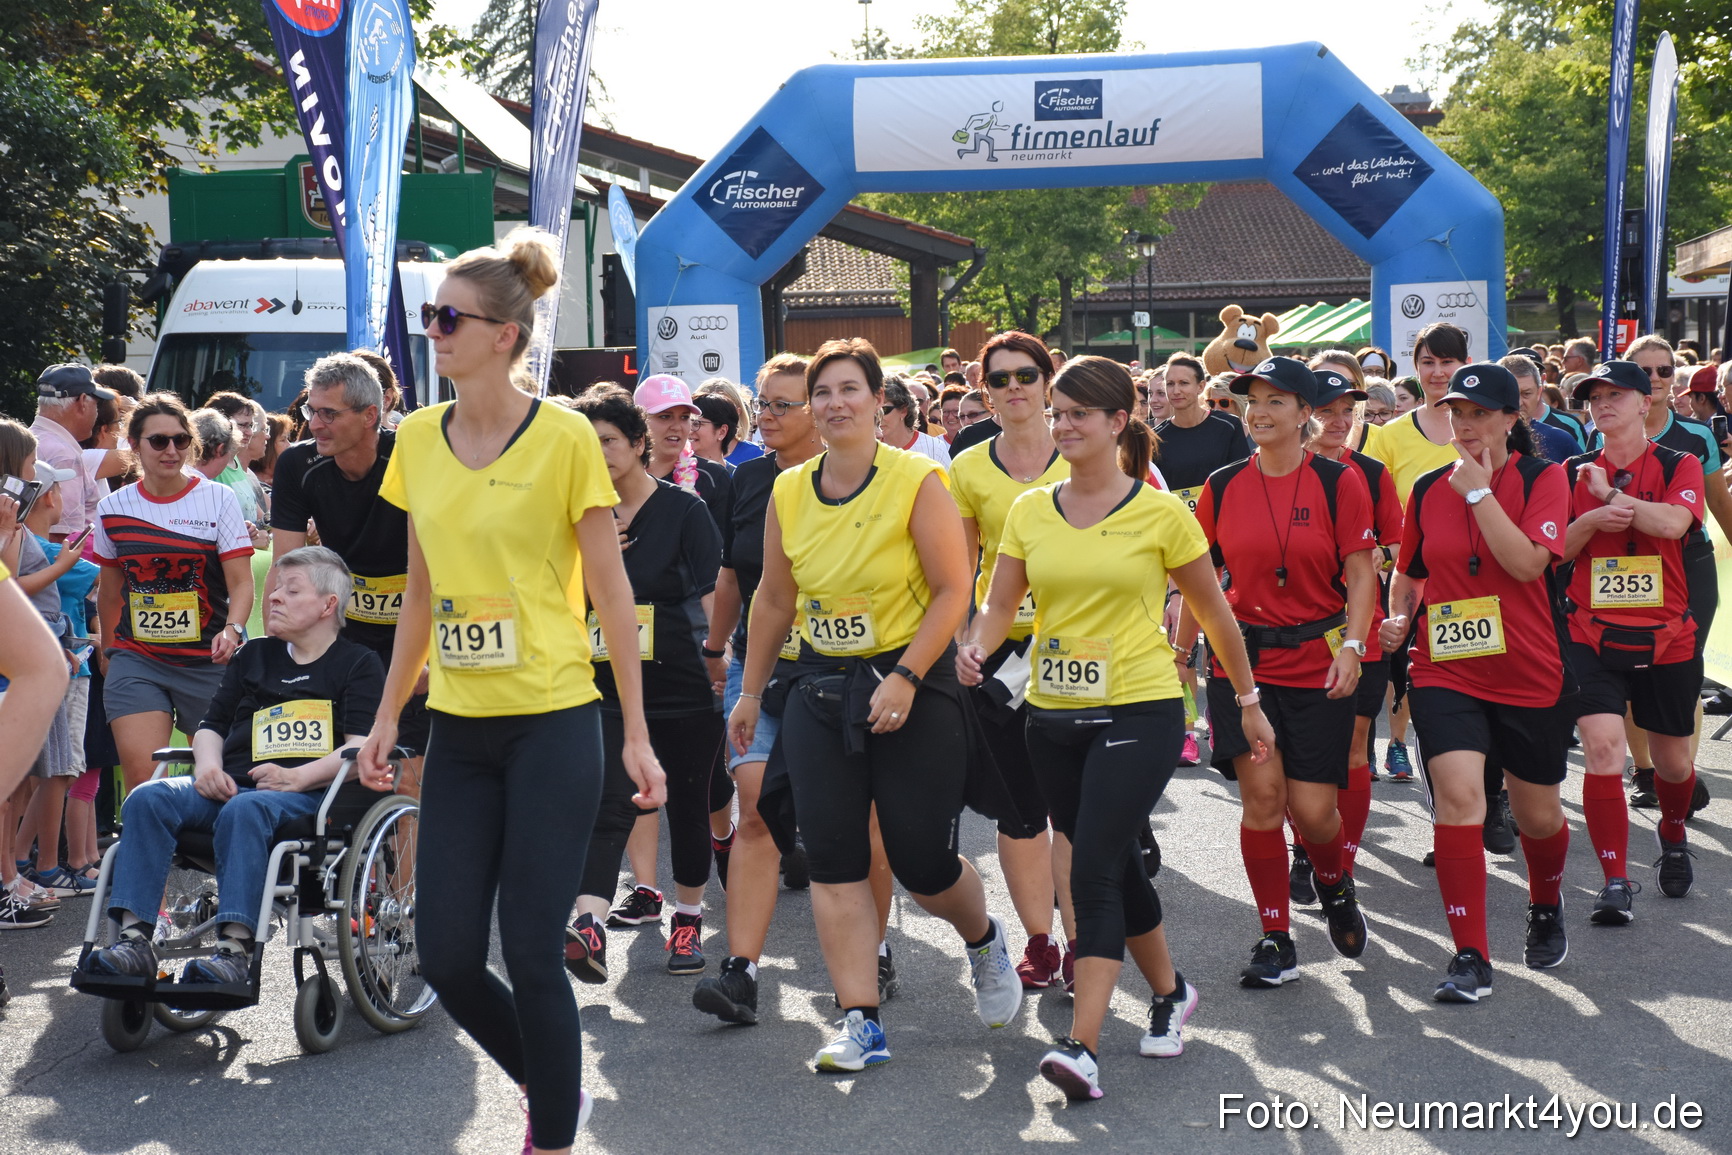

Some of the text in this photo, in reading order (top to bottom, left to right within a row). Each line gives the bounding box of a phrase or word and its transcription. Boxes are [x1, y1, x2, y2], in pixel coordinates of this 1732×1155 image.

[1049, 95, 1099, 106] Fischer
[1011, 118, 1162, 150] firmenlauf
[1011, 150, 1073, 161] neumarkt
[1322, 162, 1345, 175] und
[1346, 159, 1369, 171] das
[1370, 156, 1416, 169] Lächeln
[1386, 168, 1413, 180] mit!
[725, 183, 805, 200] Fischer
[732, 200, 798, 209] AUTOMOBILE
[183, 298, 250, 313] abavent
[1135, 313, 1147, 325] WC
[704, 355, 719, 368] FIAT
[660, 380, 685, 399] LA
[1293, 507, 1310, 521] 10
[169, 519, 209, 527] NEUMARKT
[1599, 574, 1653, 593] 2353
[351, 591, 403, 611] 1974
[138, 610, 190, 629] 2254
[810, 615, 866, 639] 2185
[440, 621, 502, 651] 2191
[1436, 618, 1491, 644] 2360
[1443, 643, 1468, 651] Seemeier
[470, 652, 504, 660] Cornelia
[1042, 658, 1100, 684] 2196
[262, 720, 323, 743] 1993
